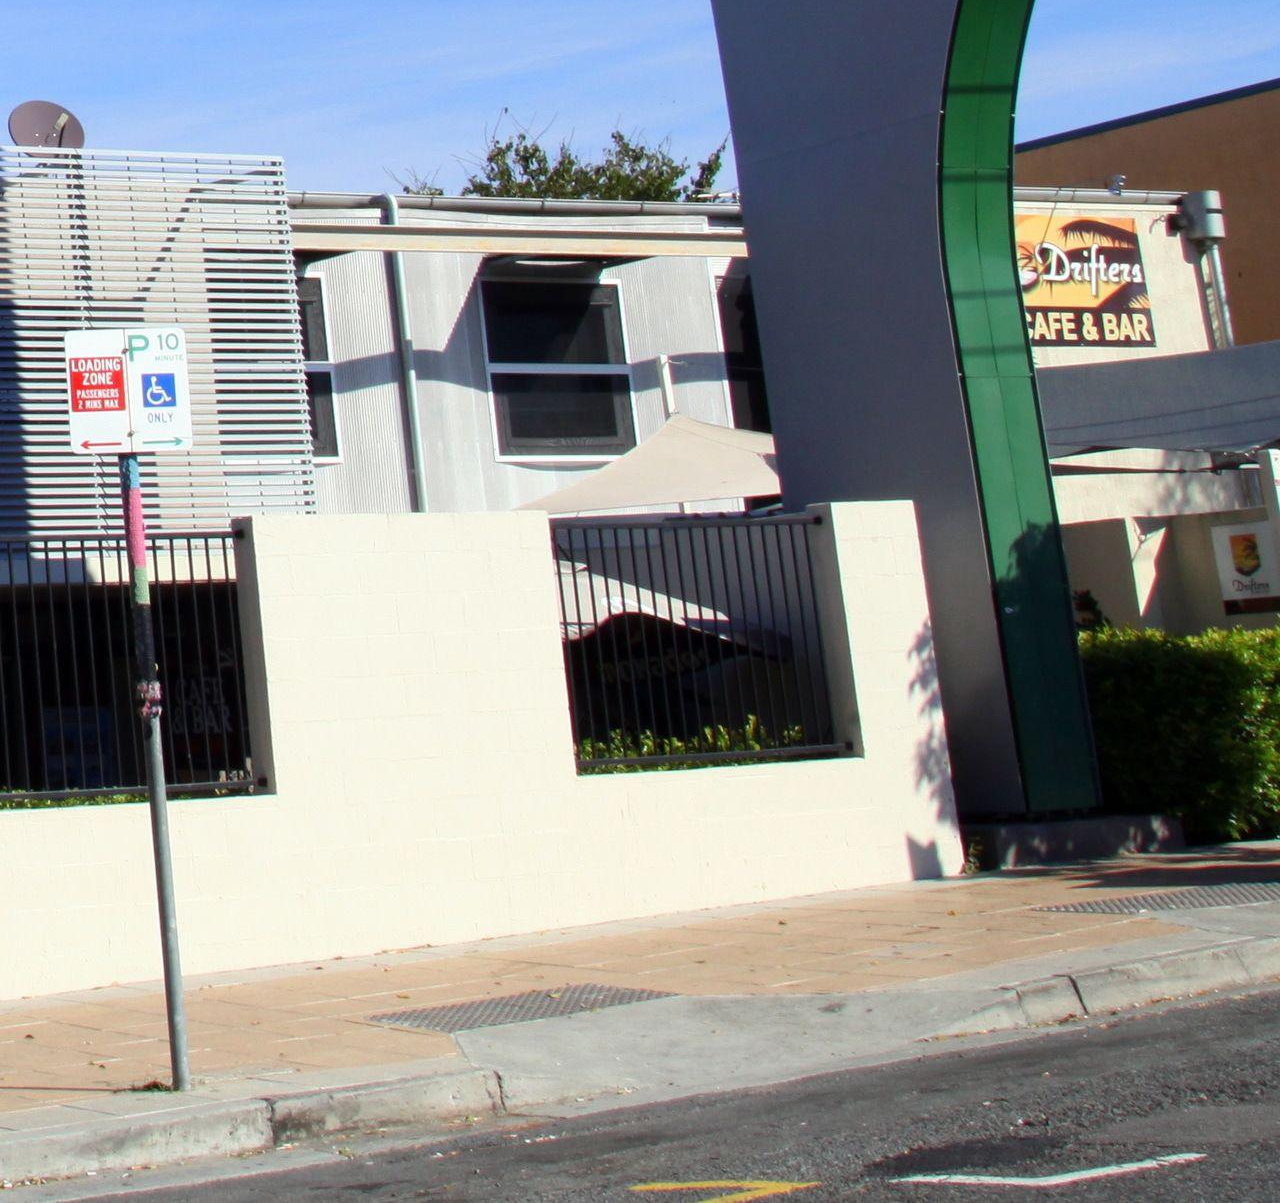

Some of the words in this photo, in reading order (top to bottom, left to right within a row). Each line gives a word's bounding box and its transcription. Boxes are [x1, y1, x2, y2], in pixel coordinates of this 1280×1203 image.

[1036, 241, 1144, 296] Drifters
[1082, 312, 1099, 340] &
[1102, 312, 1151, 341] BAR
[128, 334, 149, 362] P
[157, 333, 179, 350] 10
[71, 358, 121, 372] LOADING
[82, 372, 113, 386] ZONE
[76, 388, 120, 399] PASSENGERS
[78, 400, 83, 410] 2
[85, 399, 102, 410] MINS
[104, 398, 120, 409] MAX
[147, 412, 174, 424] ONLY
